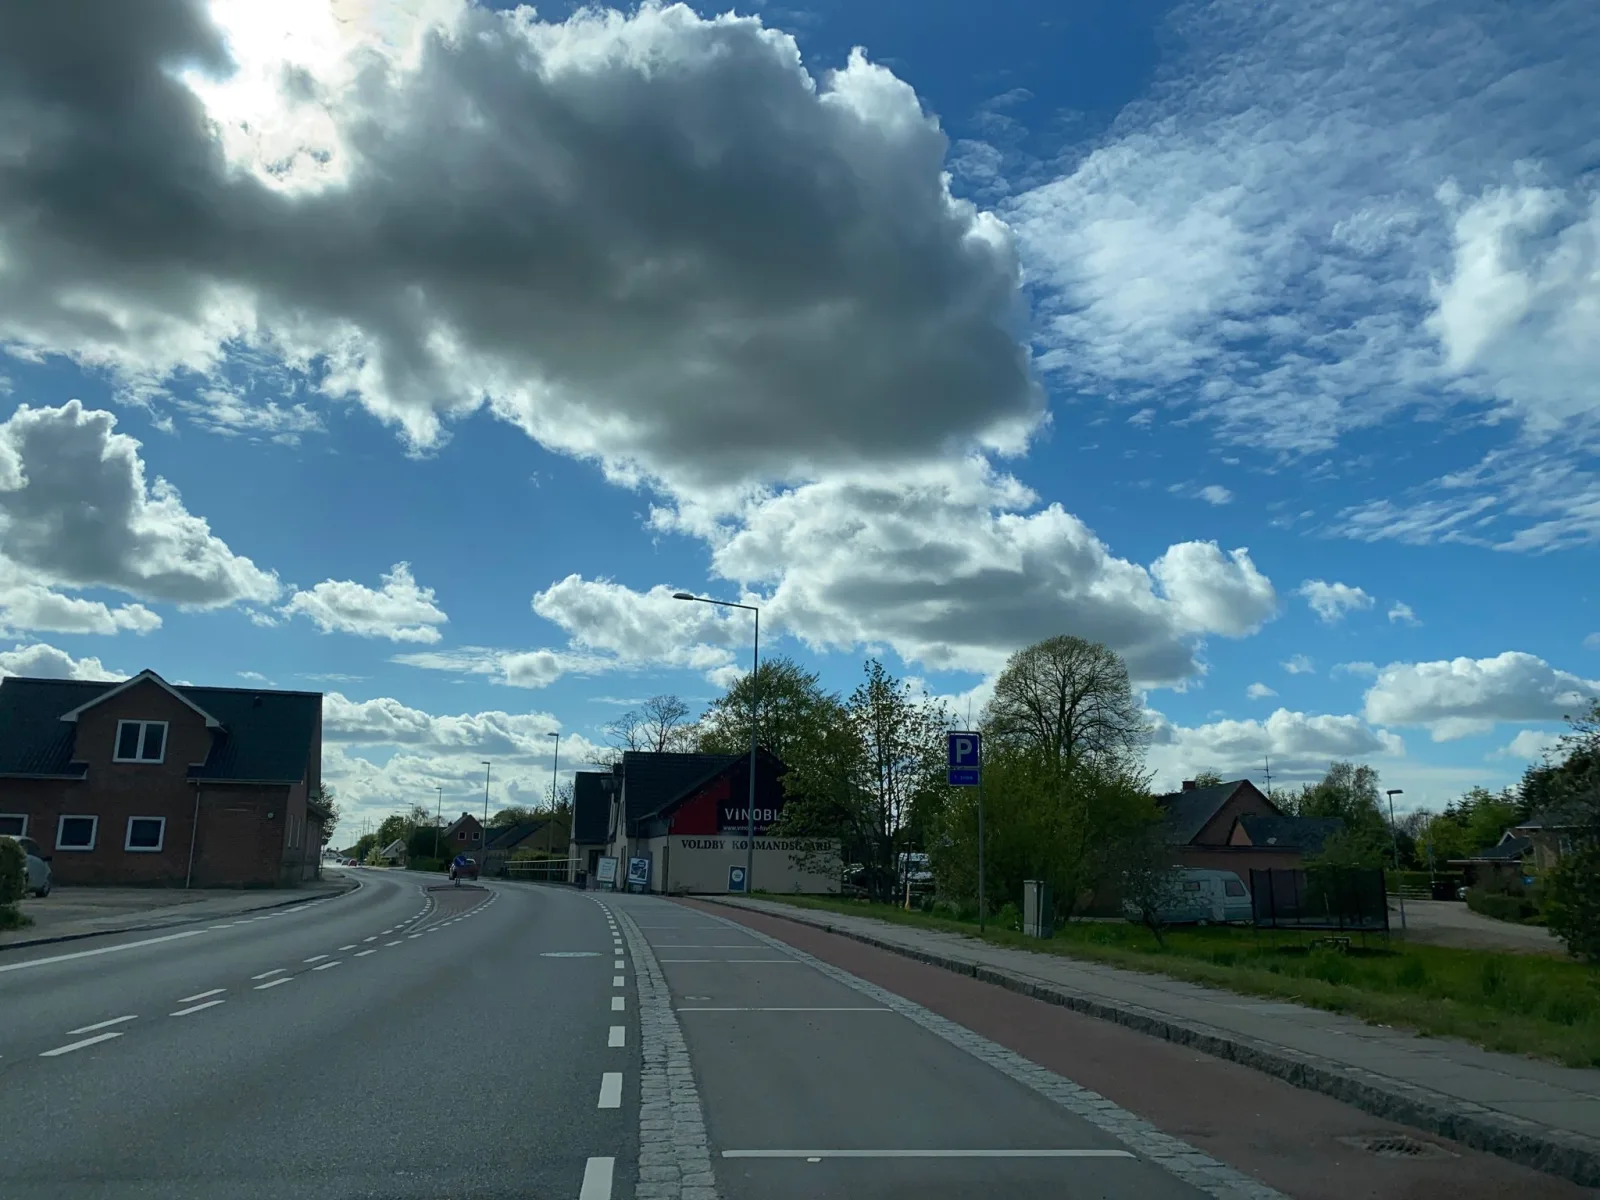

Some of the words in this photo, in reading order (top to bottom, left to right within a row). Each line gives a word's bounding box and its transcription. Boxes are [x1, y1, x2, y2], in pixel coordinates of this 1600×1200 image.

[955, 738, 973, 764] P
[681, 839, 727, 849] VOLDBY
[732, 839, 832, 851] KØBMANDSGARD
